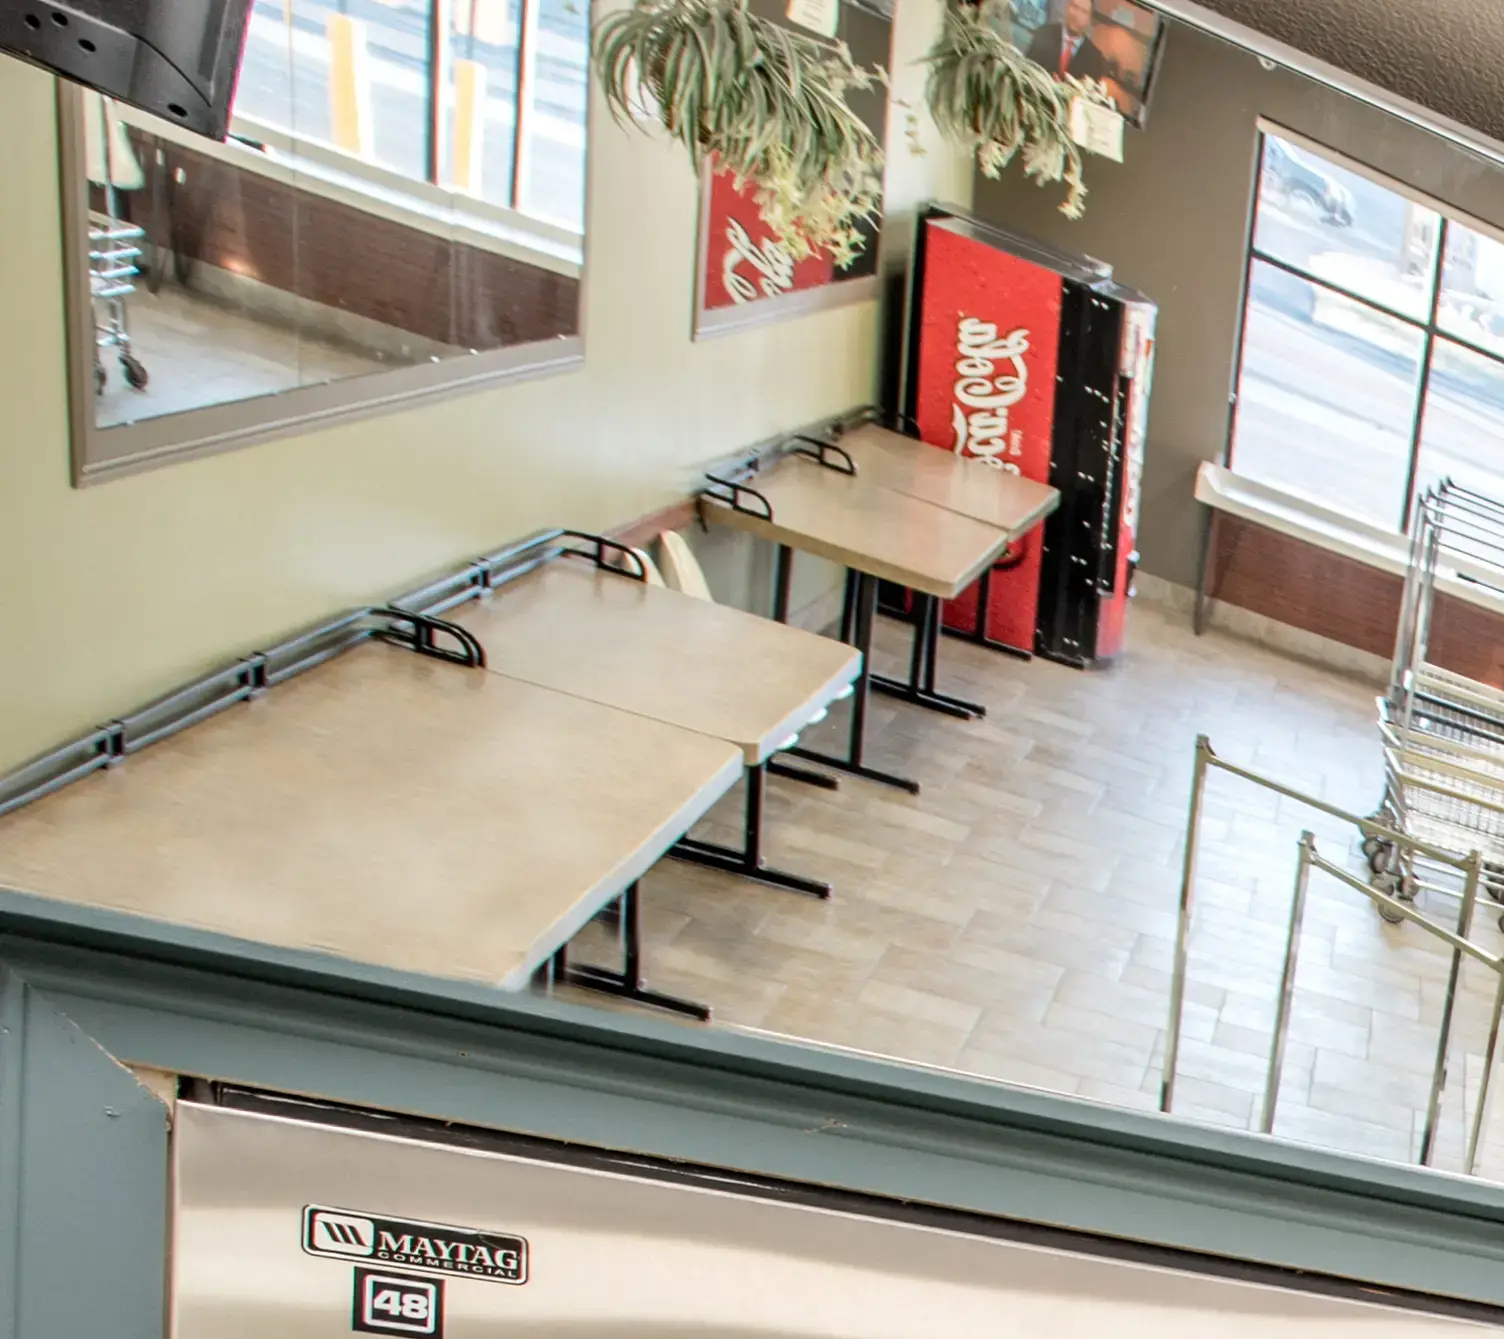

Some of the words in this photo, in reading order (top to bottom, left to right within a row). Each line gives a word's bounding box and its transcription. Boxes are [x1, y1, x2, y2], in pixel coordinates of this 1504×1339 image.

[378, 1230, 518, 1270] MAYTAG
[378, 1251, 517, 1278] COMMERCIAL
[373, 1290, 429, 1319] 48
